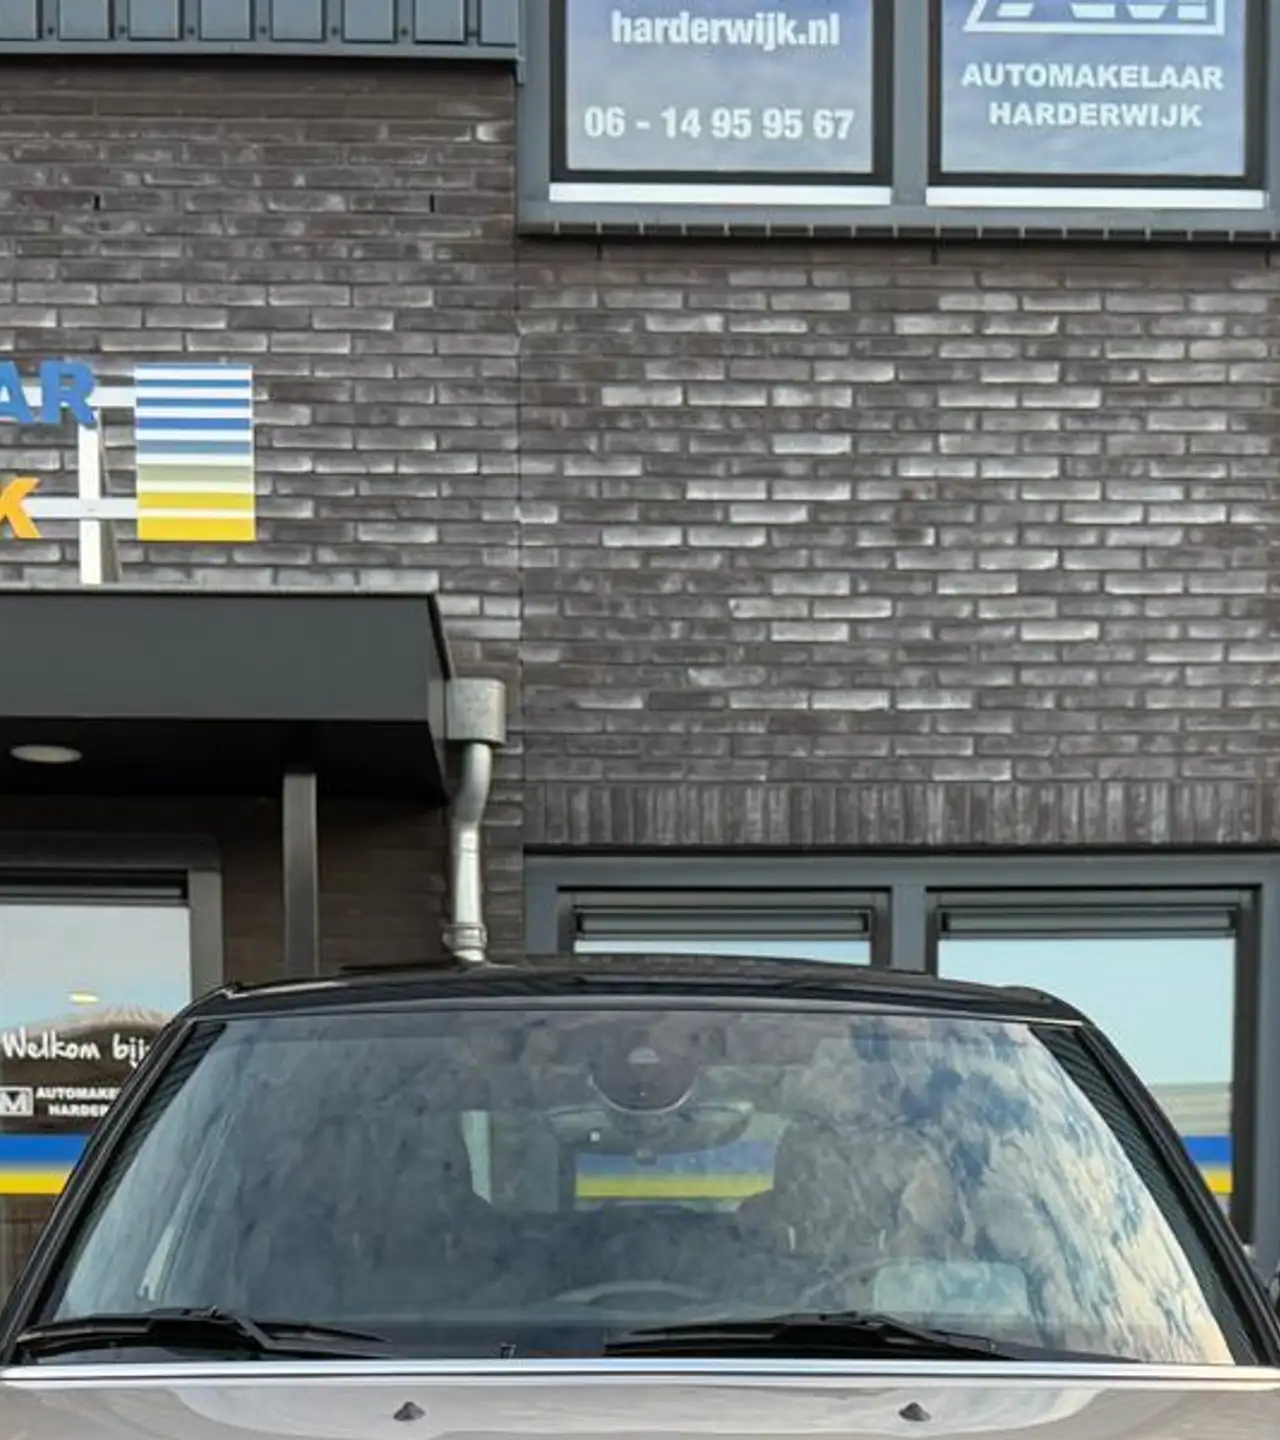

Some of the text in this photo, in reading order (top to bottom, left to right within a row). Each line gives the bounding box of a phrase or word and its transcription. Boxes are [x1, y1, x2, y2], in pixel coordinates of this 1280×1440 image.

[611, 9, 840, 51] harderwijk.nl
[961, 62, 1225, 90] AUTOMAKELAAR
[584, 105, 626, 138] 06
[661, 106, 701, 138] 14
[711, 107, 752, 139] 95
[762, 107, 803, 139] 95
[813, 109, 855, 140] 67
[989, 101, 1203, 128] HARDERWIJK
[2, 1027, 101, 1060] Welkom
